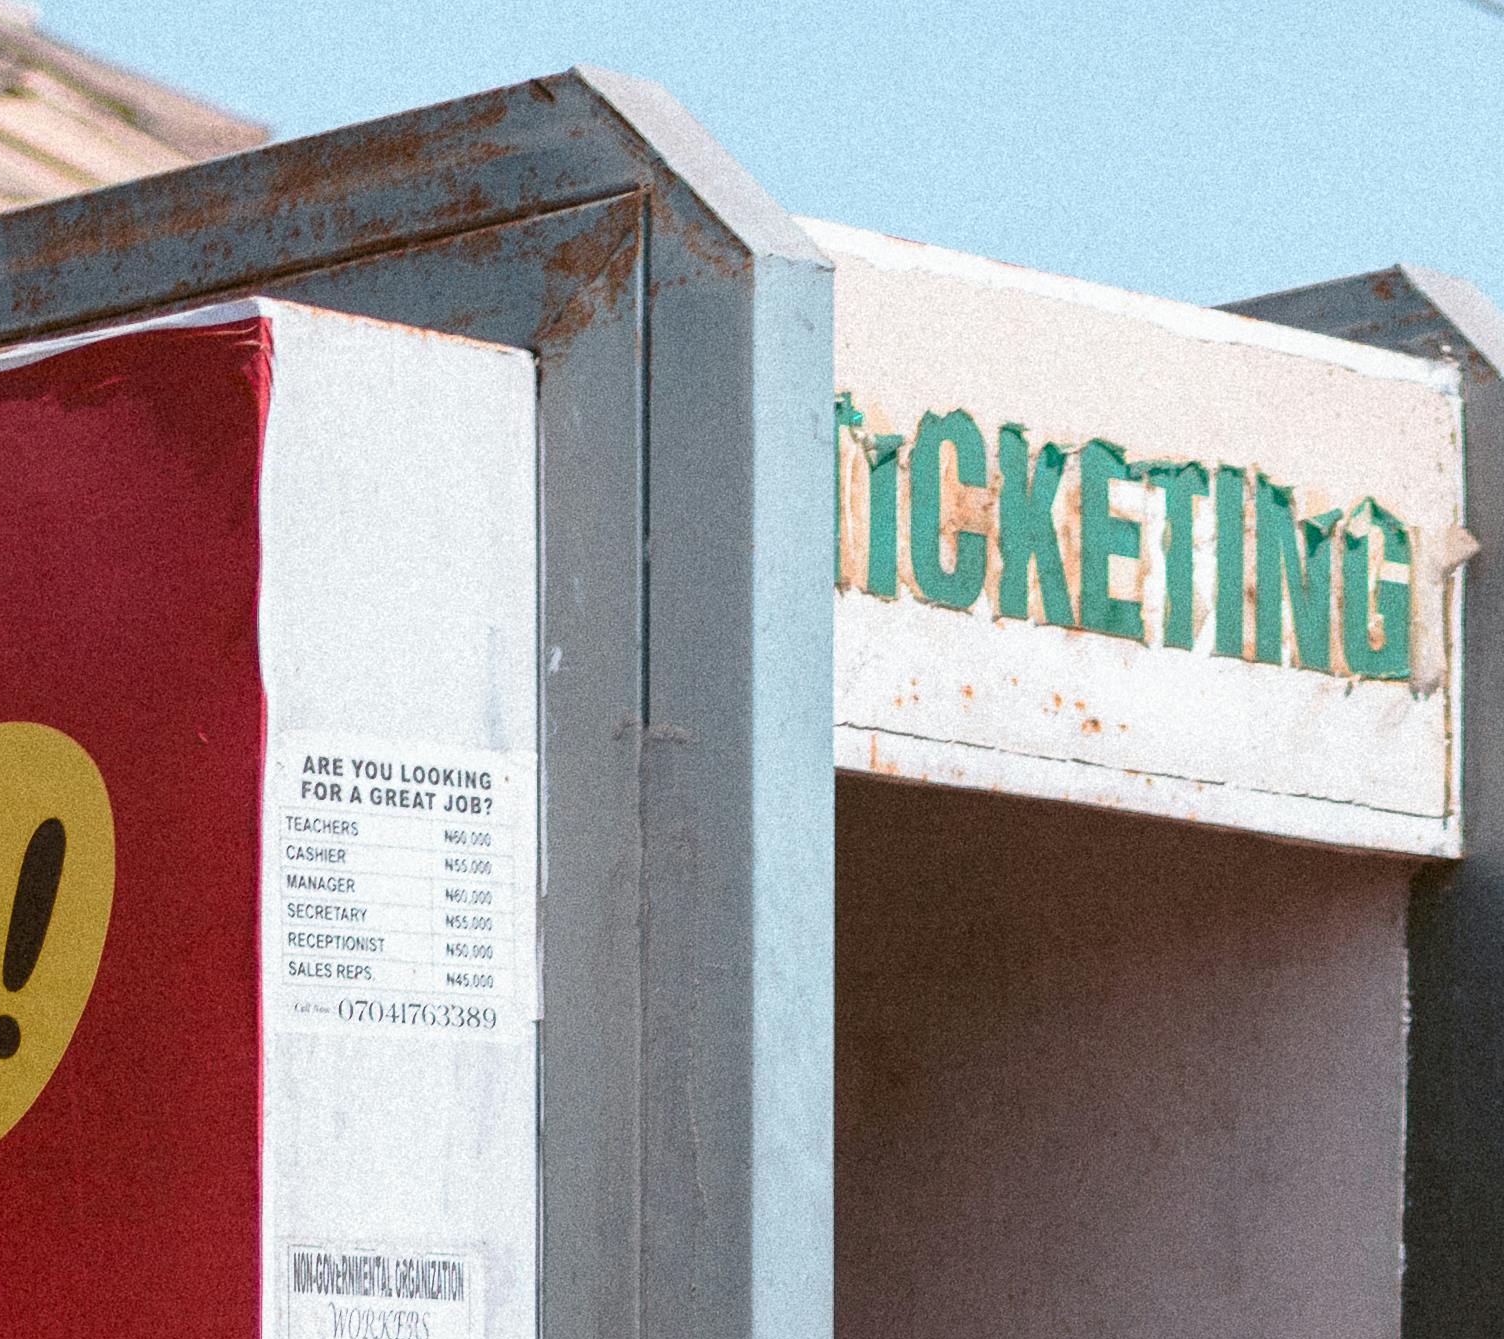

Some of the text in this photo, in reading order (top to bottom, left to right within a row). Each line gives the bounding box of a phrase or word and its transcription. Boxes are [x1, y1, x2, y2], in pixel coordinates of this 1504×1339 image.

[303, 755, 492, 790] ARE YOU LOOKING
[301, 781, 493, 815] FOR A GREAT JOB?
[286, 816, 359, 836] TEACHERS
[286, 845, 346, 864] CASHIER
[286, 874, 356, 893] MANAGER
[287, 903, 367, 922] SECRETARY
[287, 932, 385, 952] RECEPTIONIST
[288, 961, 332, 977] SALES
[338, 999, 496, 1030] 07041763389
[293, 1253, 464, 1301] NON-GOVERNMENTAL ORGANIZATION
